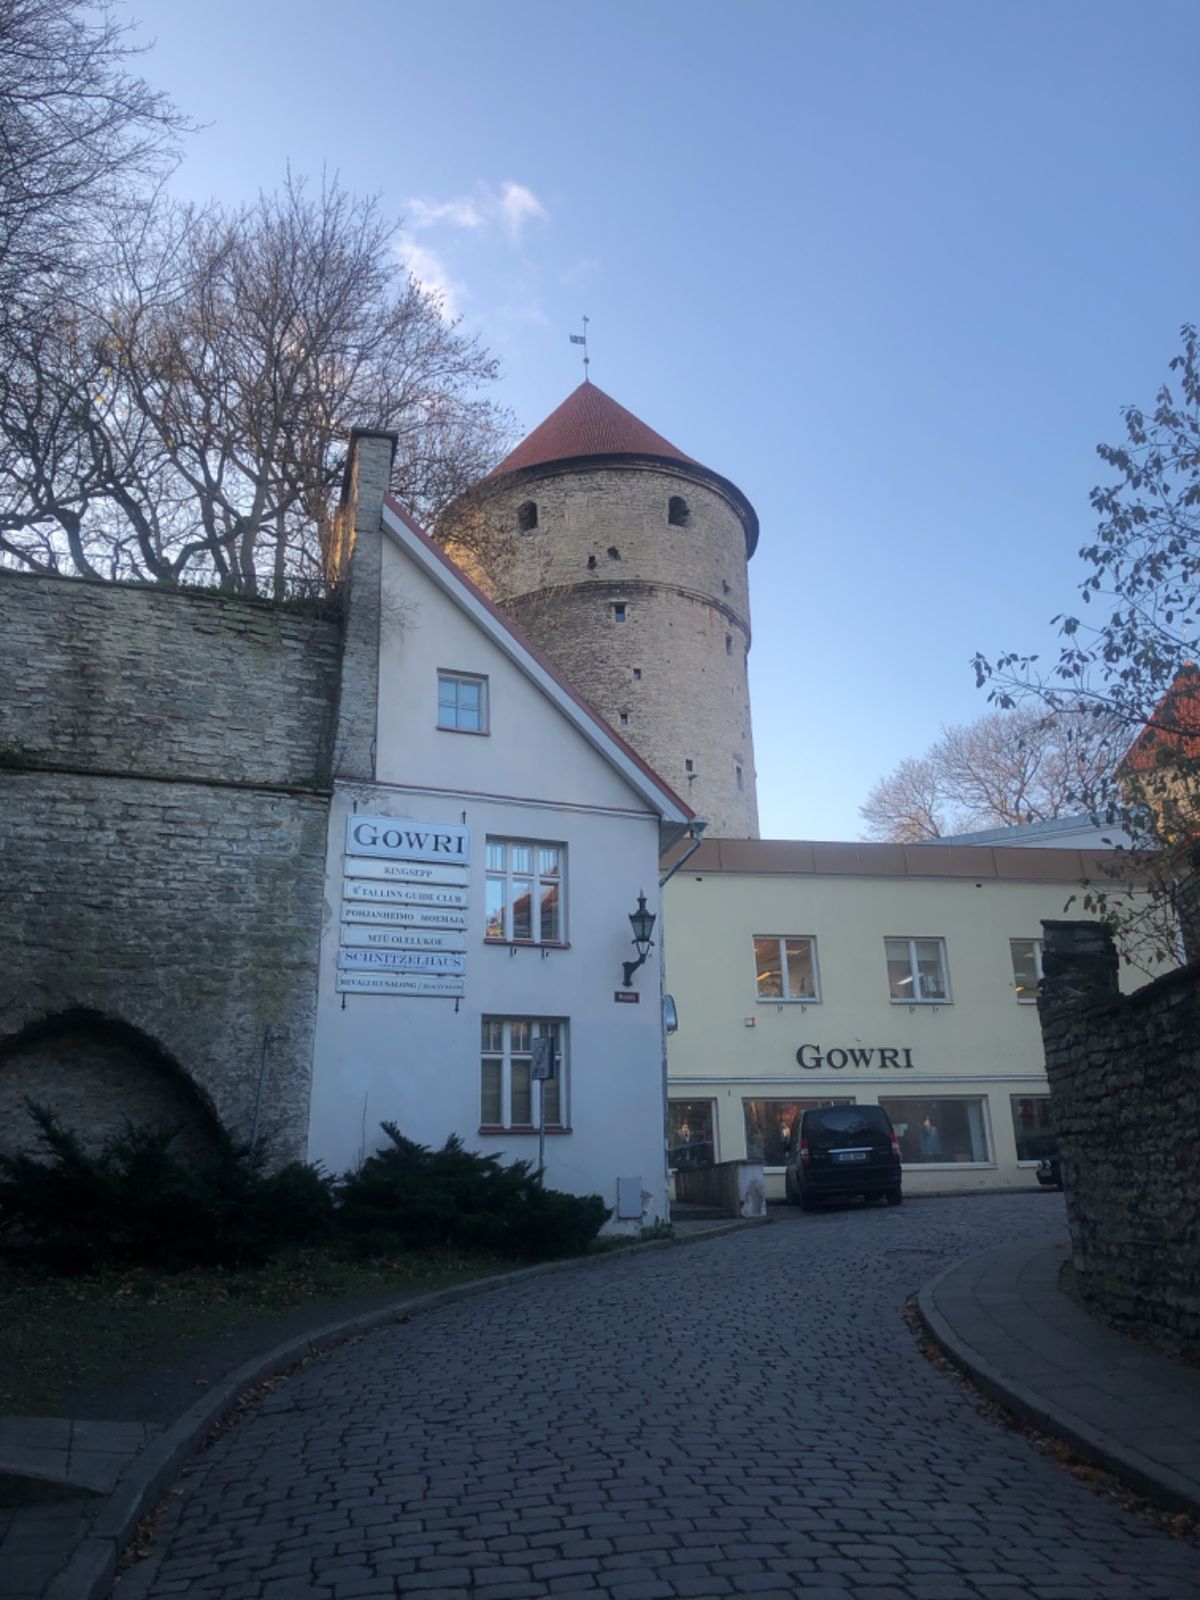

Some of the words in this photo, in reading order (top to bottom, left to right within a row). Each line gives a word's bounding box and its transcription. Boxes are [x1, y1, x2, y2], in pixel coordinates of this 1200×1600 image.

[353, 823, 465, 854] GOWRI
[384, 866, 433, 878] KINGSEPP
[405, 891, 434, 902] GUIDE
[436, 894, 462, 903] CLUB
[345, 951, 462, 968] SCHNITZELHAUS
[796, 1043, 915, 1070] GOWRI
